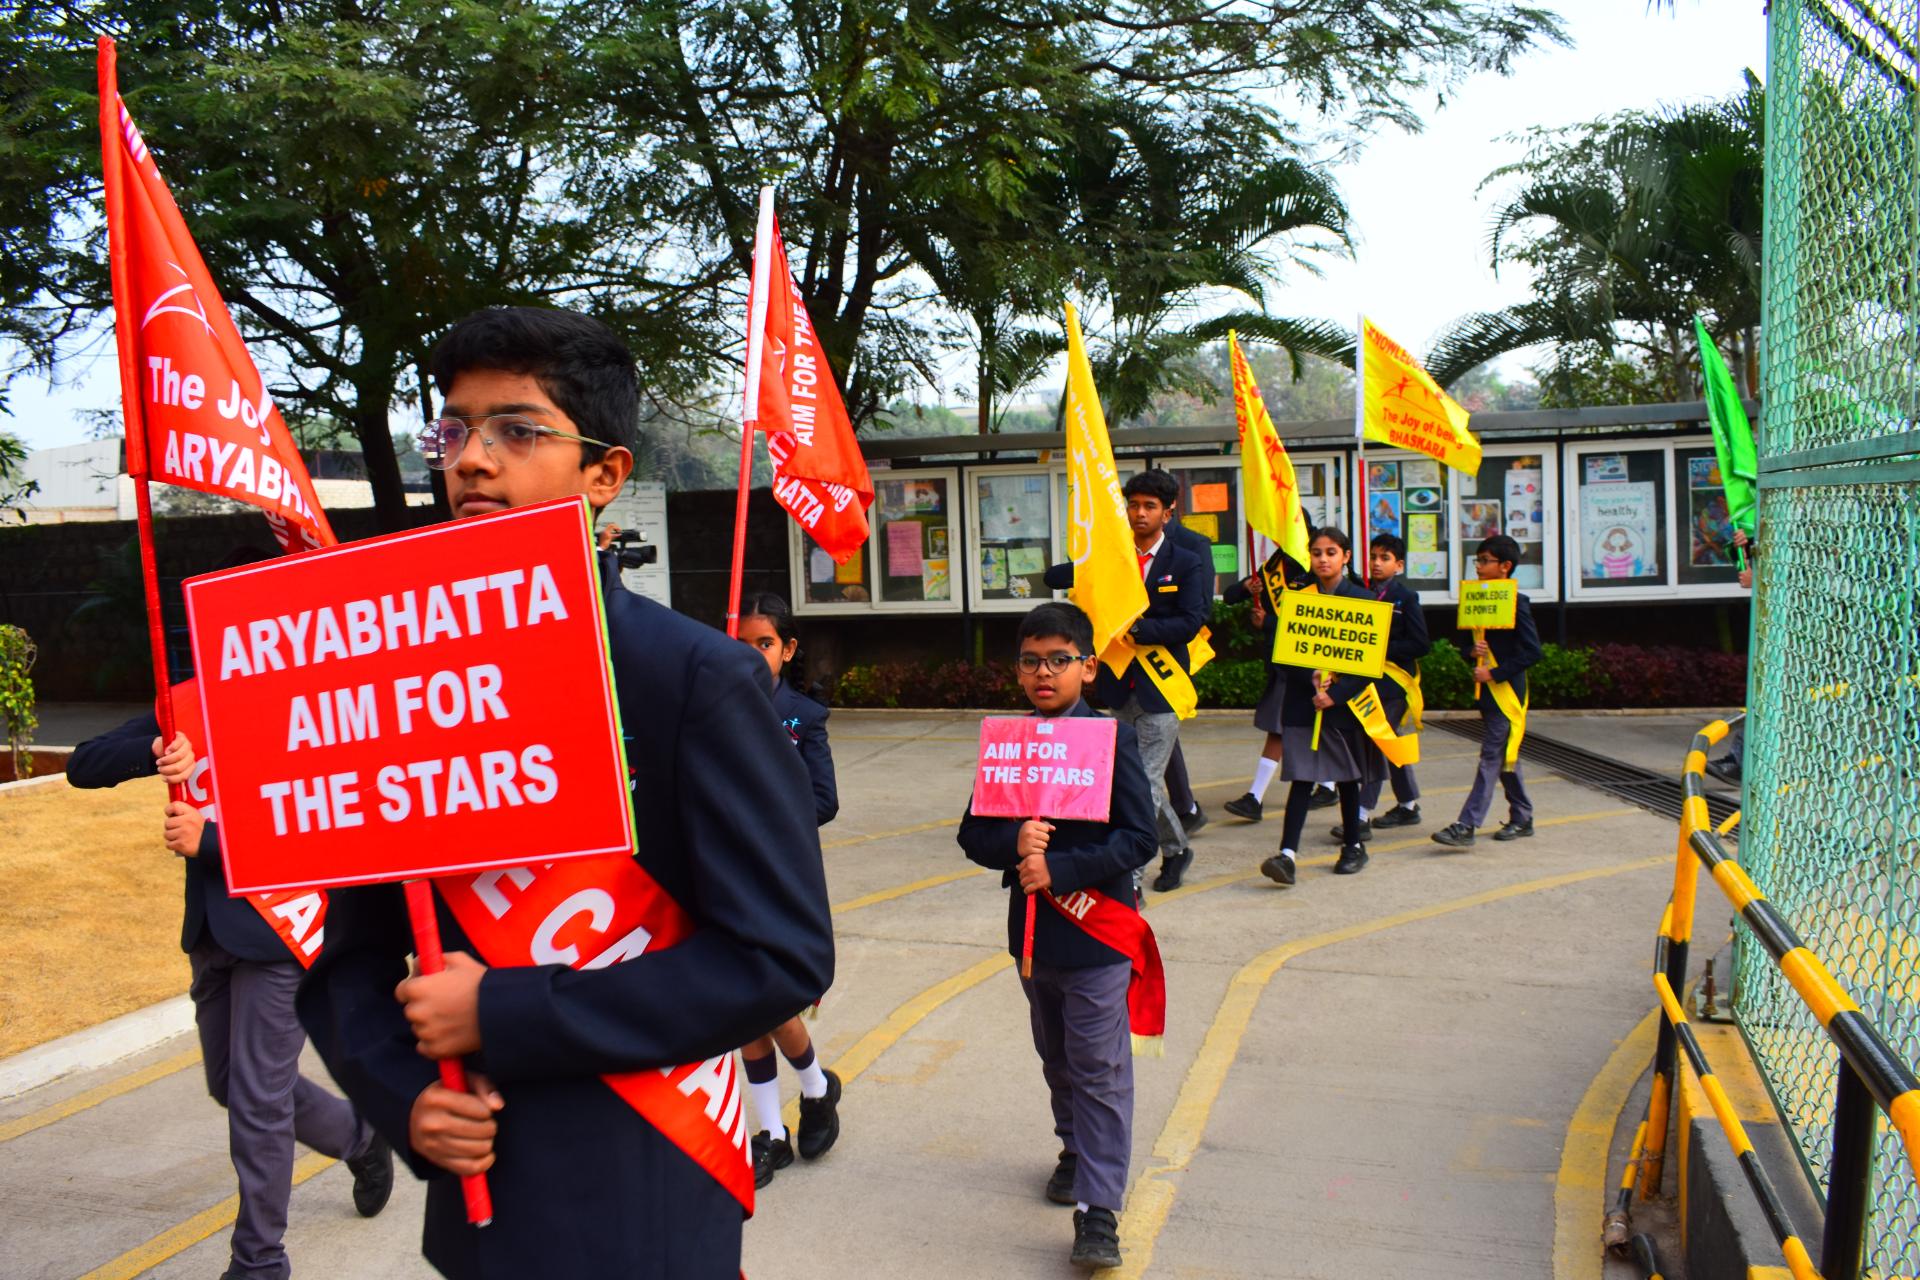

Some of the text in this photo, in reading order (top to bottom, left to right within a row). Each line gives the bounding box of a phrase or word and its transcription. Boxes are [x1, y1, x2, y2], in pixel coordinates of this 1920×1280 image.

[792, 303, 813, 348] THE
[791, 353, 817, 399] FOR
[148, 356, 274, 447] The Joy
[789, 404, 815, 447] AIM
[1383, 407, 1399, 421] The
[1400, 412, 1421, 431] Joy
[1422, 422, 1434, 433] of
[1389, 429, 1446, 460] BHASKARA
[1097, 463, 1114, 480] of
[1466, 590, 1509, 601] KNOWLEDGE
[220, 564, 568, 681] ARYABHATTA
[1295, 604, 1375, 626] BHASKARA
[1463, 604, 1498, 615] IS POWER
[1287, 621, 1378, 645] KNOWLEDGE
[1295, 641, 1364, 662] IS POWER
[286, 663, 509, 752] AIM FOR
[984, 742, 1068, 760] AIM FOR
[260, 770, 365, 836] THE
[375, 743, 559, 823] STARS
[982, 766, 1095, 787] THE STARS
